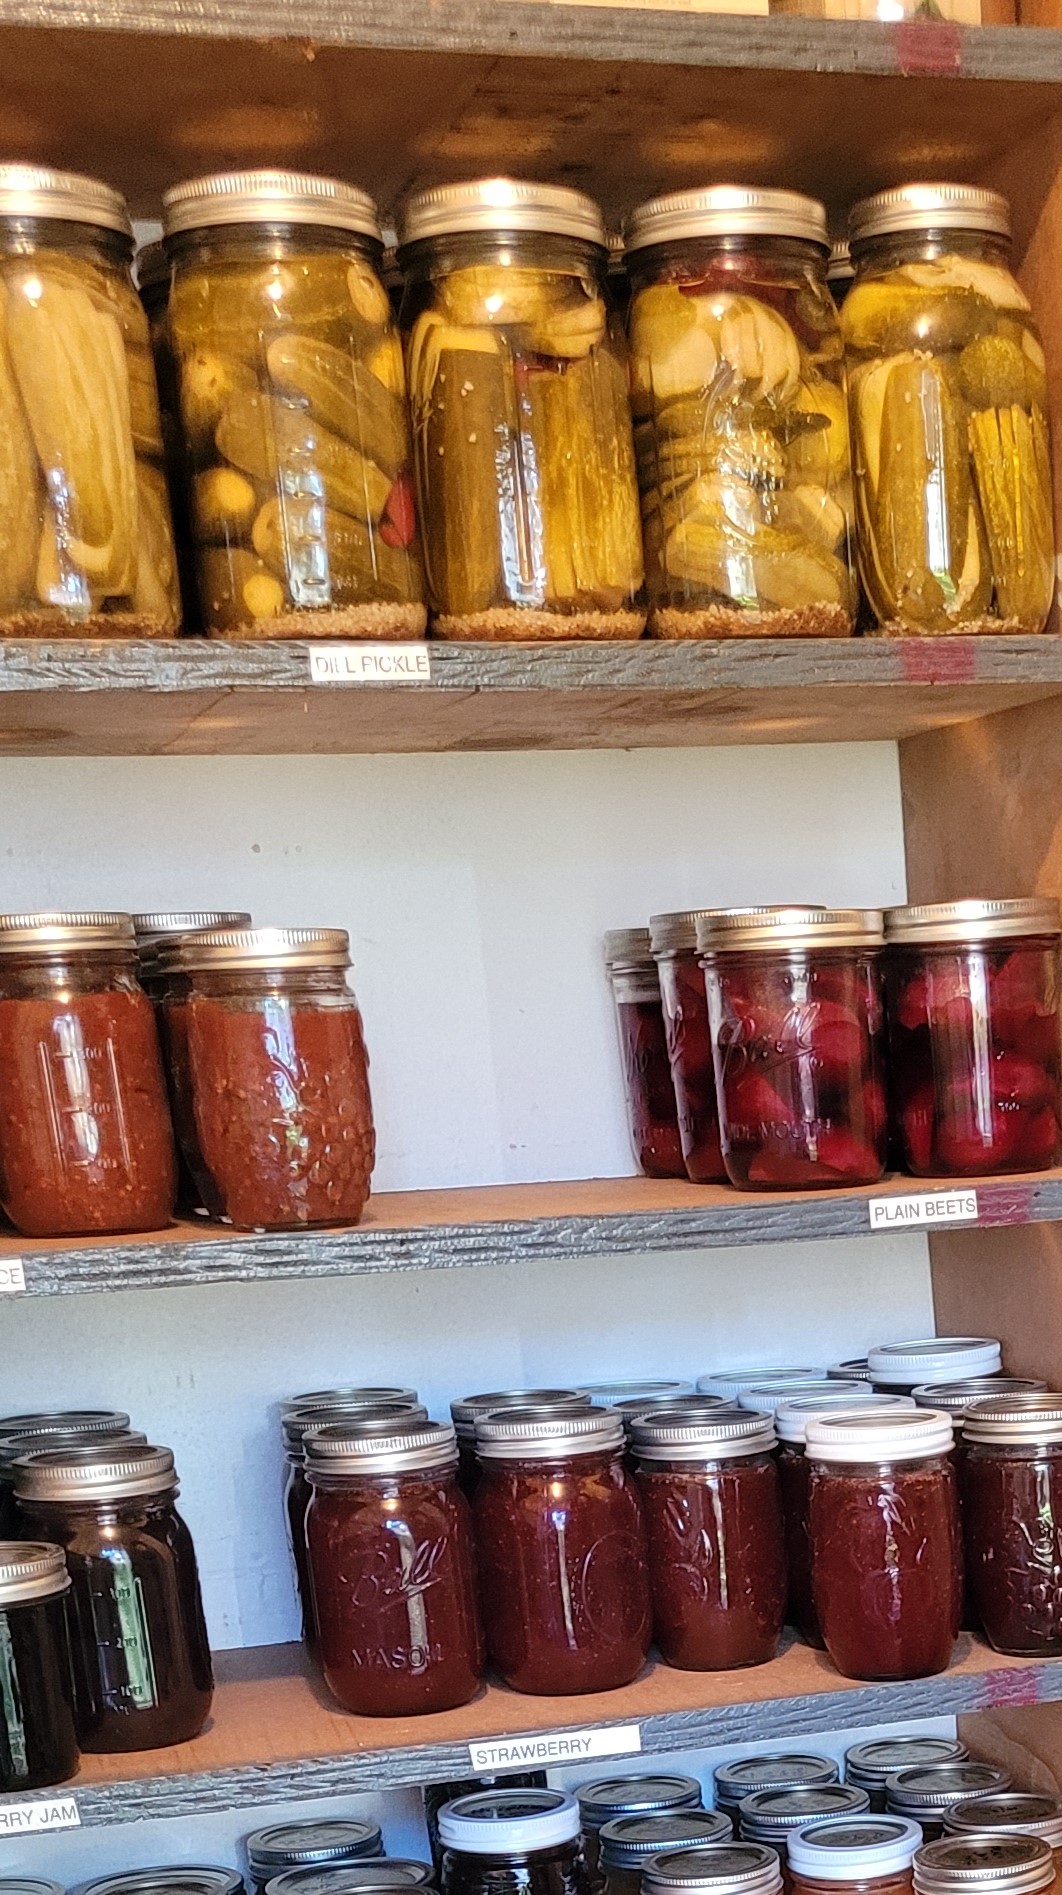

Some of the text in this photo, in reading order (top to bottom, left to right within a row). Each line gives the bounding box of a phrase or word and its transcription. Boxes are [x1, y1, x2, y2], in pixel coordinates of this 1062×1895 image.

[314, 654, 429, 675] DILL PICKLE
[874, 1197, 976, 1222] PLAIN BEETS
[476, 1737, 592, 1765] STRAWBERRY
[39, 1804, 77, 1824] JAM
